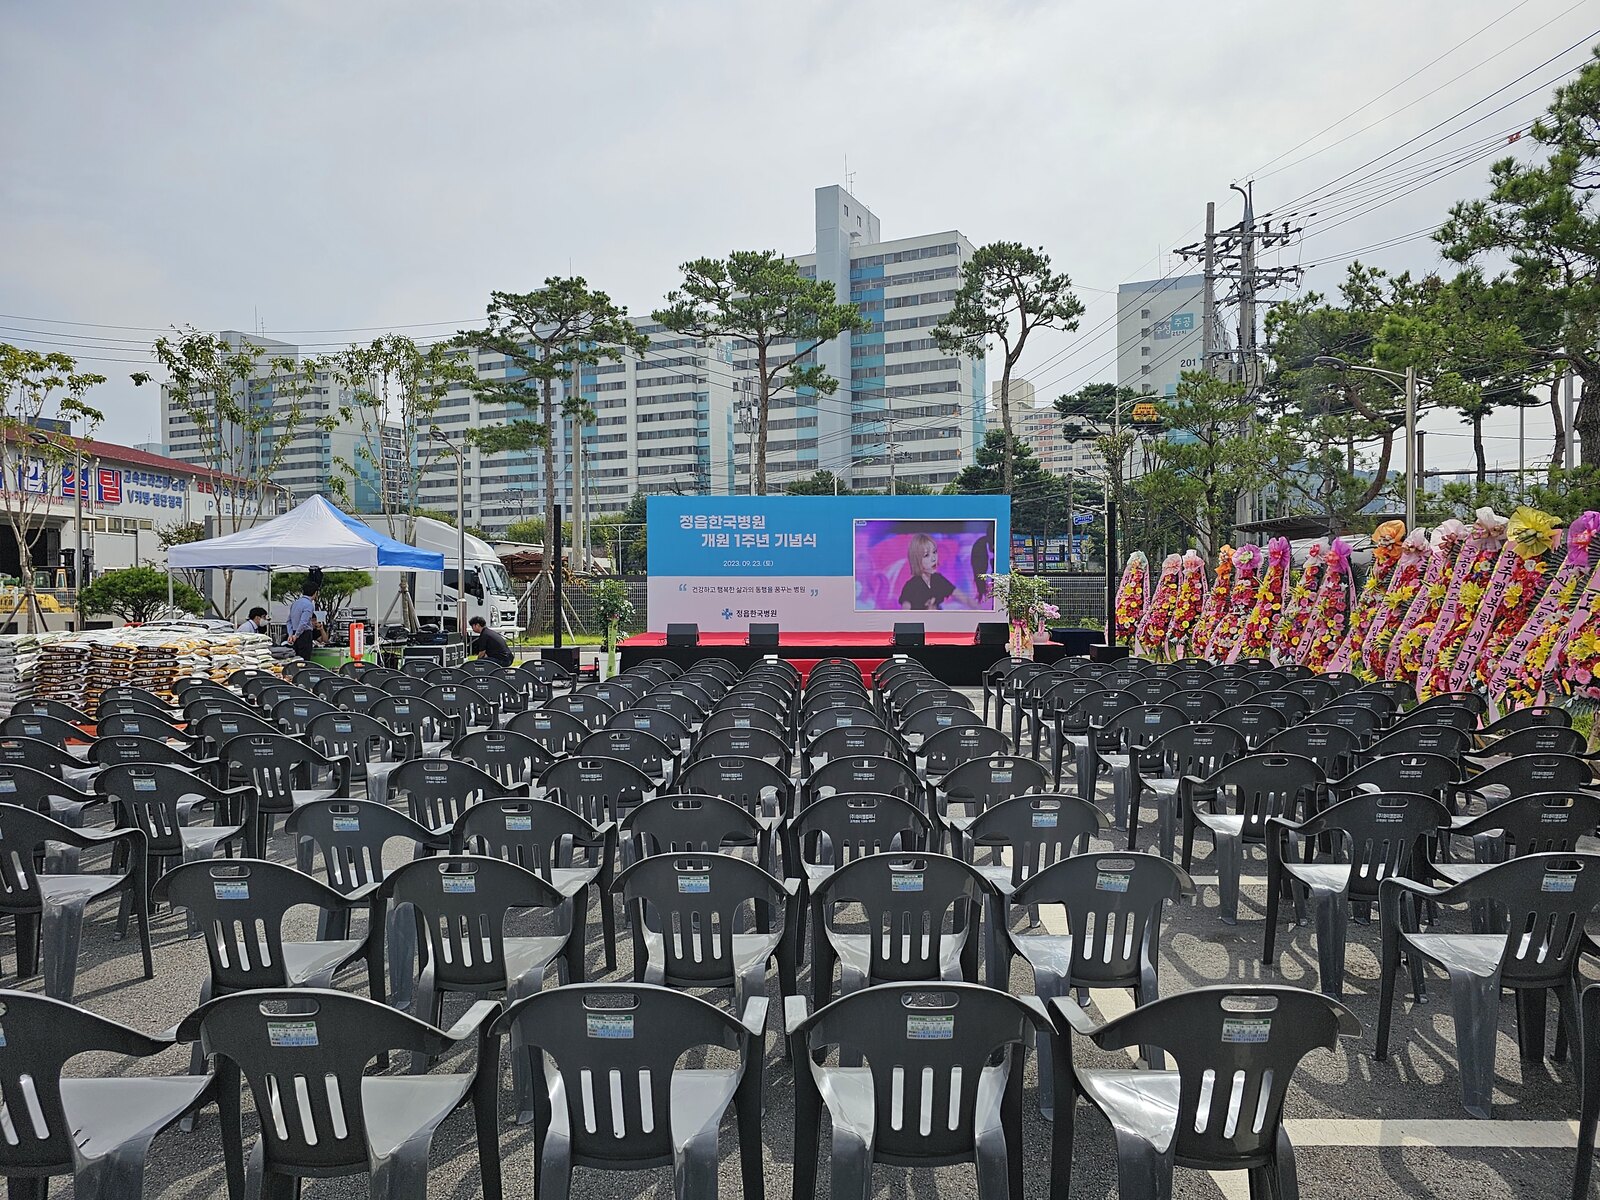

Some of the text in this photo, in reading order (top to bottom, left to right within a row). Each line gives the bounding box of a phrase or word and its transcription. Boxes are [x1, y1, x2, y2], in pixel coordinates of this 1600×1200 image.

[1174, 316, 1192, 328] 주공
[1180, 358, 1196, 368] 201
[680, 515, 766, 530] 정읍한국병원
[701, 533, 817, 548] 개원 1주년 기념식
[692, 586, 716, 594] 건강하고
[717, 586, 735, 594] 행복한
[755, 586, 773, 594] 동행을
[793, 586, 806, 594] 병원
[736, 609, 777, 618] 정읍한국병원
[1506, 640, 1529, 664] 대표
